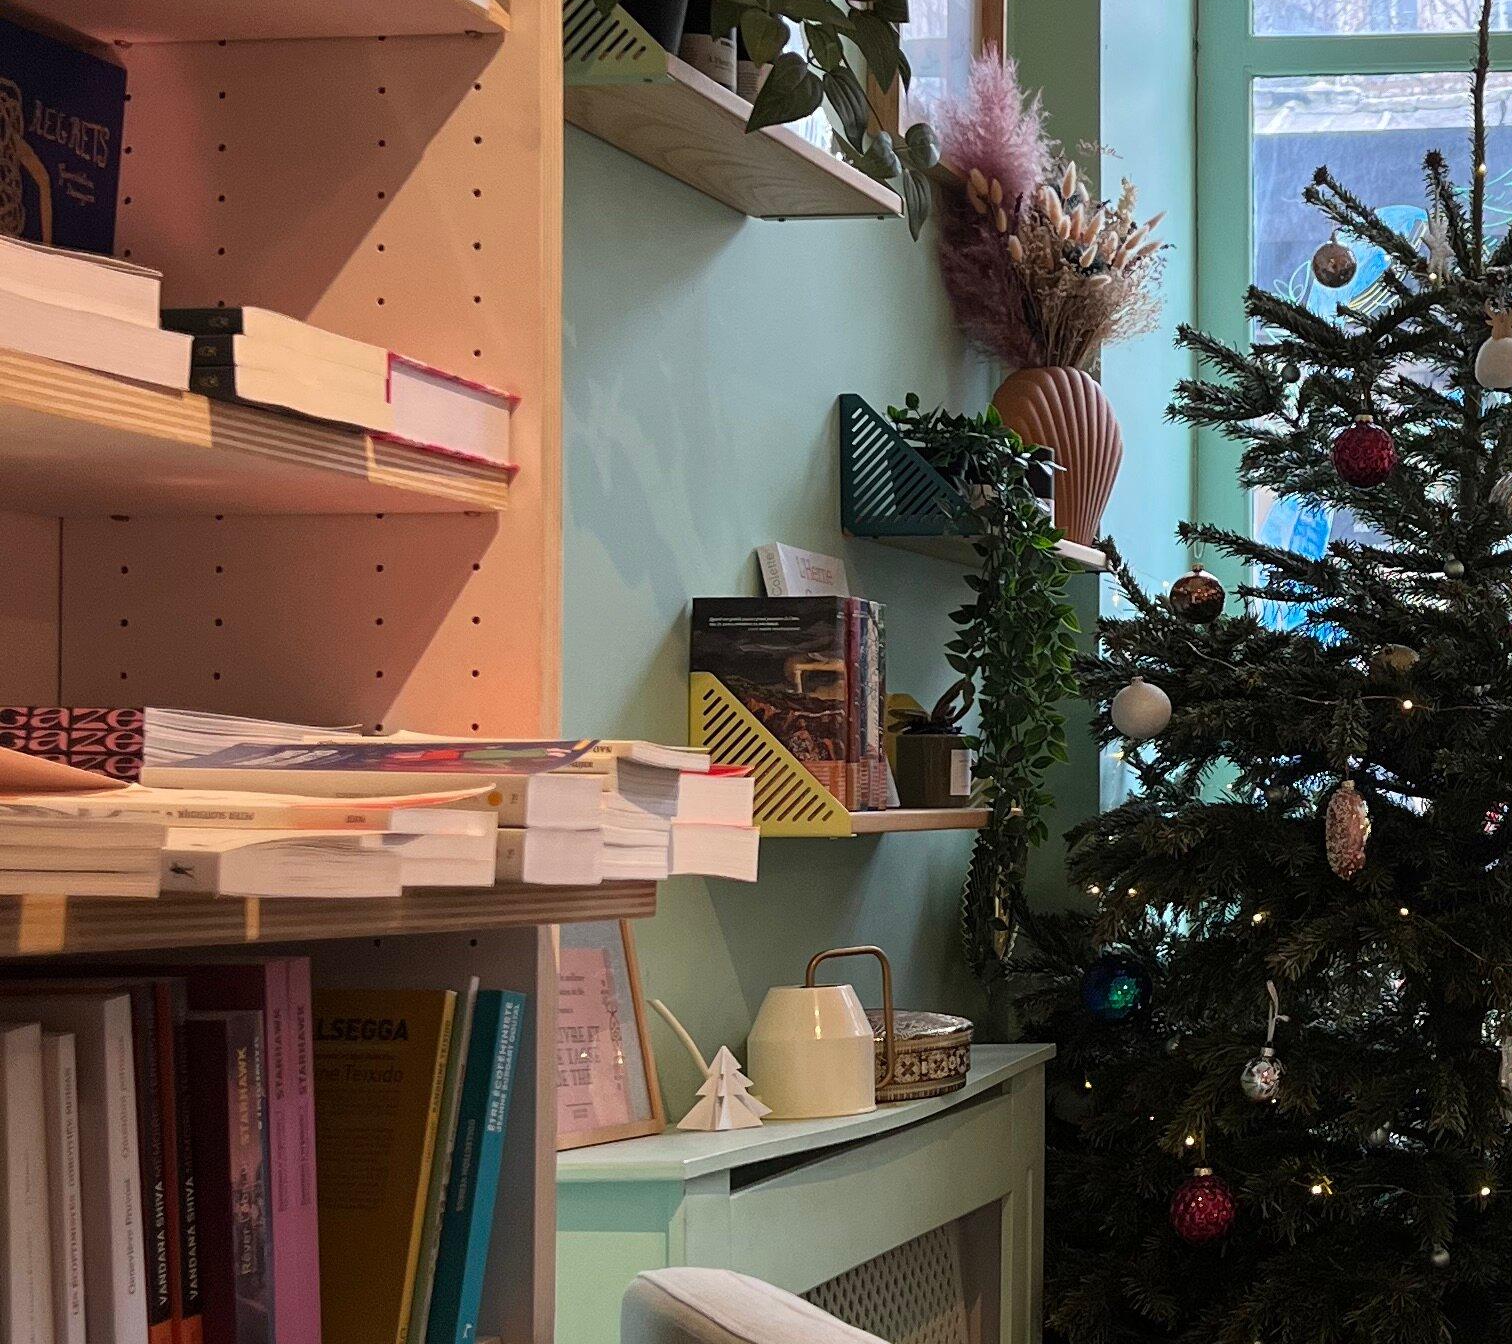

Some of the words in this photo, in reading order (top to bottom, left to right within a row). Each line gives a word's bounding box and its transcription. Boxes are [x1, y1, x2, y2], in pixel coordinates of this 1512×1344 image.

[770, 552, 783, 597] Colette
[273, 1007, 284, 1100] STARHAWK
[297, 1003, 308, 1096] STARHAWK
[313, 1018, 409, 1042] LSEGGA
[237, 1046, 250, 1147] STARHAWK
[154, 1180, 164, 1228] SHIVA
[185, 1177, 195, 1223] SHIVA
[157, 1230, 168, 1306] VANDANA
[188, 1225, 198, 1300] VANDANA
